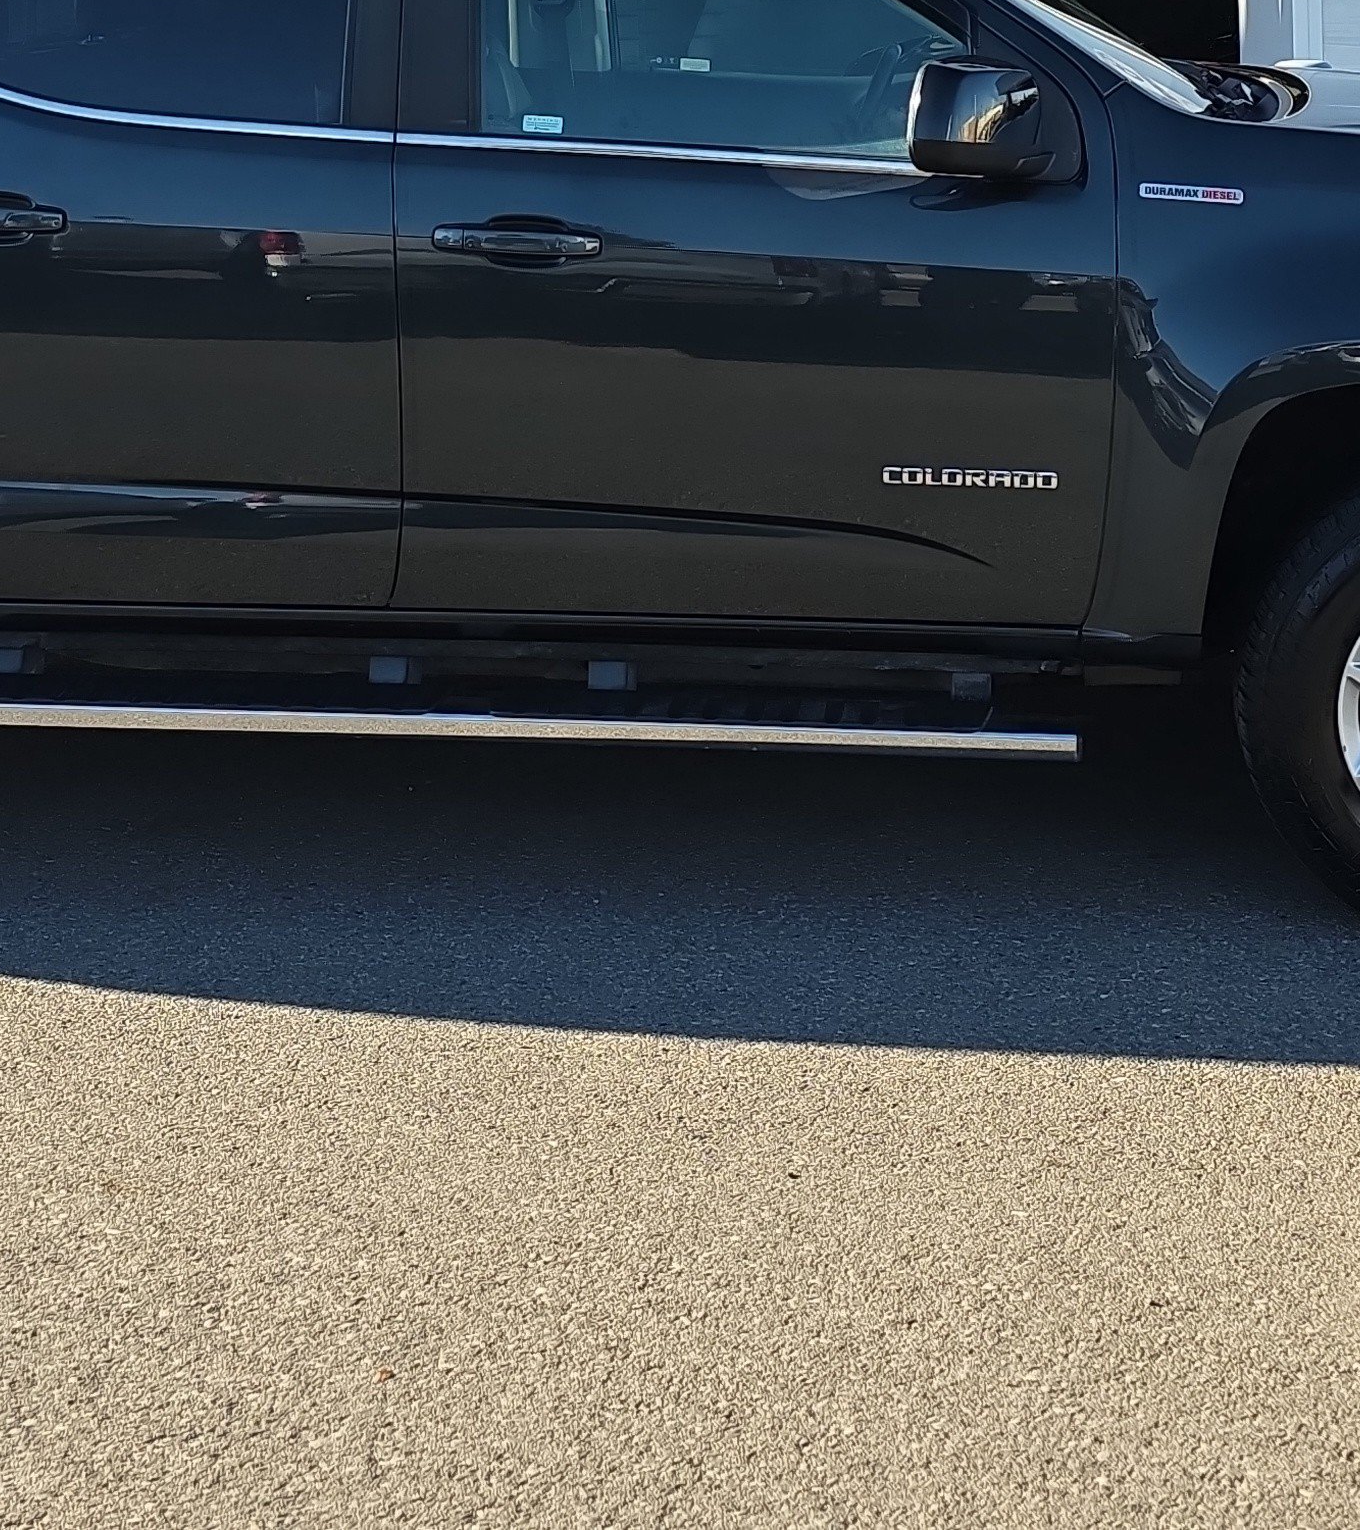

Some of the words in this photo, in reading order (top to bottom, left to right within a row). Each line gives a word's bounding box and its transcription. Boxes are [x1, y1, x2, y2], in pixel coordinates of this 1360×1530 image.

[1144, 186, 1199, 198] DURAMAX
[1201, 190, 1240, 201] DIESEL
[882, 466, 1058, 489] COLORADO
